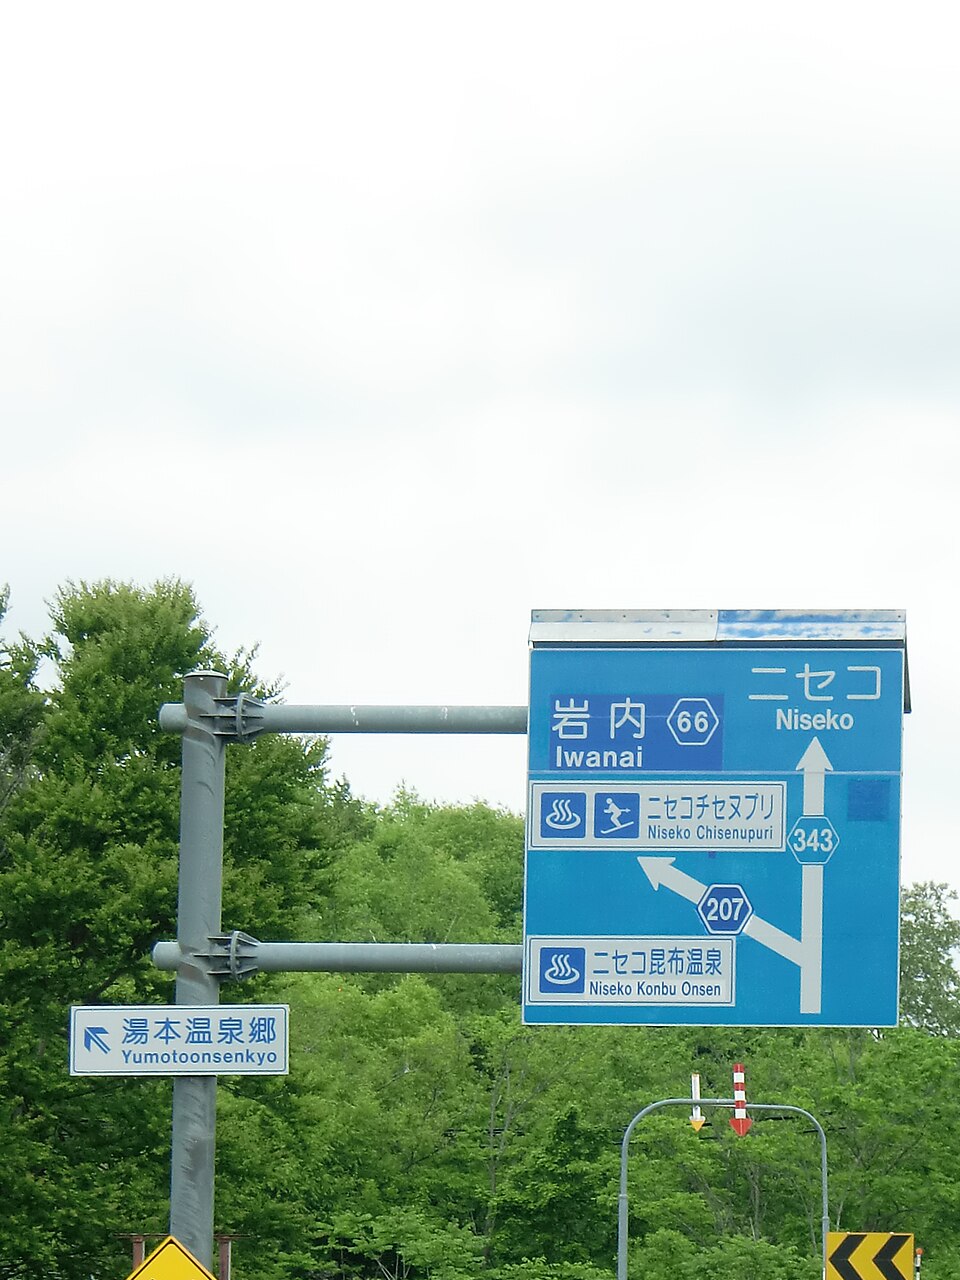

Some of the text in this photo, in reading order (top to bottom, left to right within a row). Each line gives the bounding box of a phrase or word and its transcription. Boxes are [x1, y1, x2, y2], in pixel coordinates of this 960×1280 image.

[748, 663, 881, 701] ニセコ
[552, 697, 646, 739] 岩内
[676, 710, 709, 733] 66
[776, 708, 854, 731] Niseko
[556, 745, 643, 768] Iwanai
[647, 793, 774, 820] ニセコチセヌプリ
[648, 825, 773, 843] Niseko Chisenupuri
[793, 828, 834, 852] 343
[706, 897, 744, 921] 207
[592, 947, 722, 975] ニセコ昆布温泉
[589, 981, 721, 996] Niseko Konbu Onsen
[121, 1017, 276, 1045] 湯本温泉郷
[122, 1049, 277, 1066] Yumotoonsenkyo
